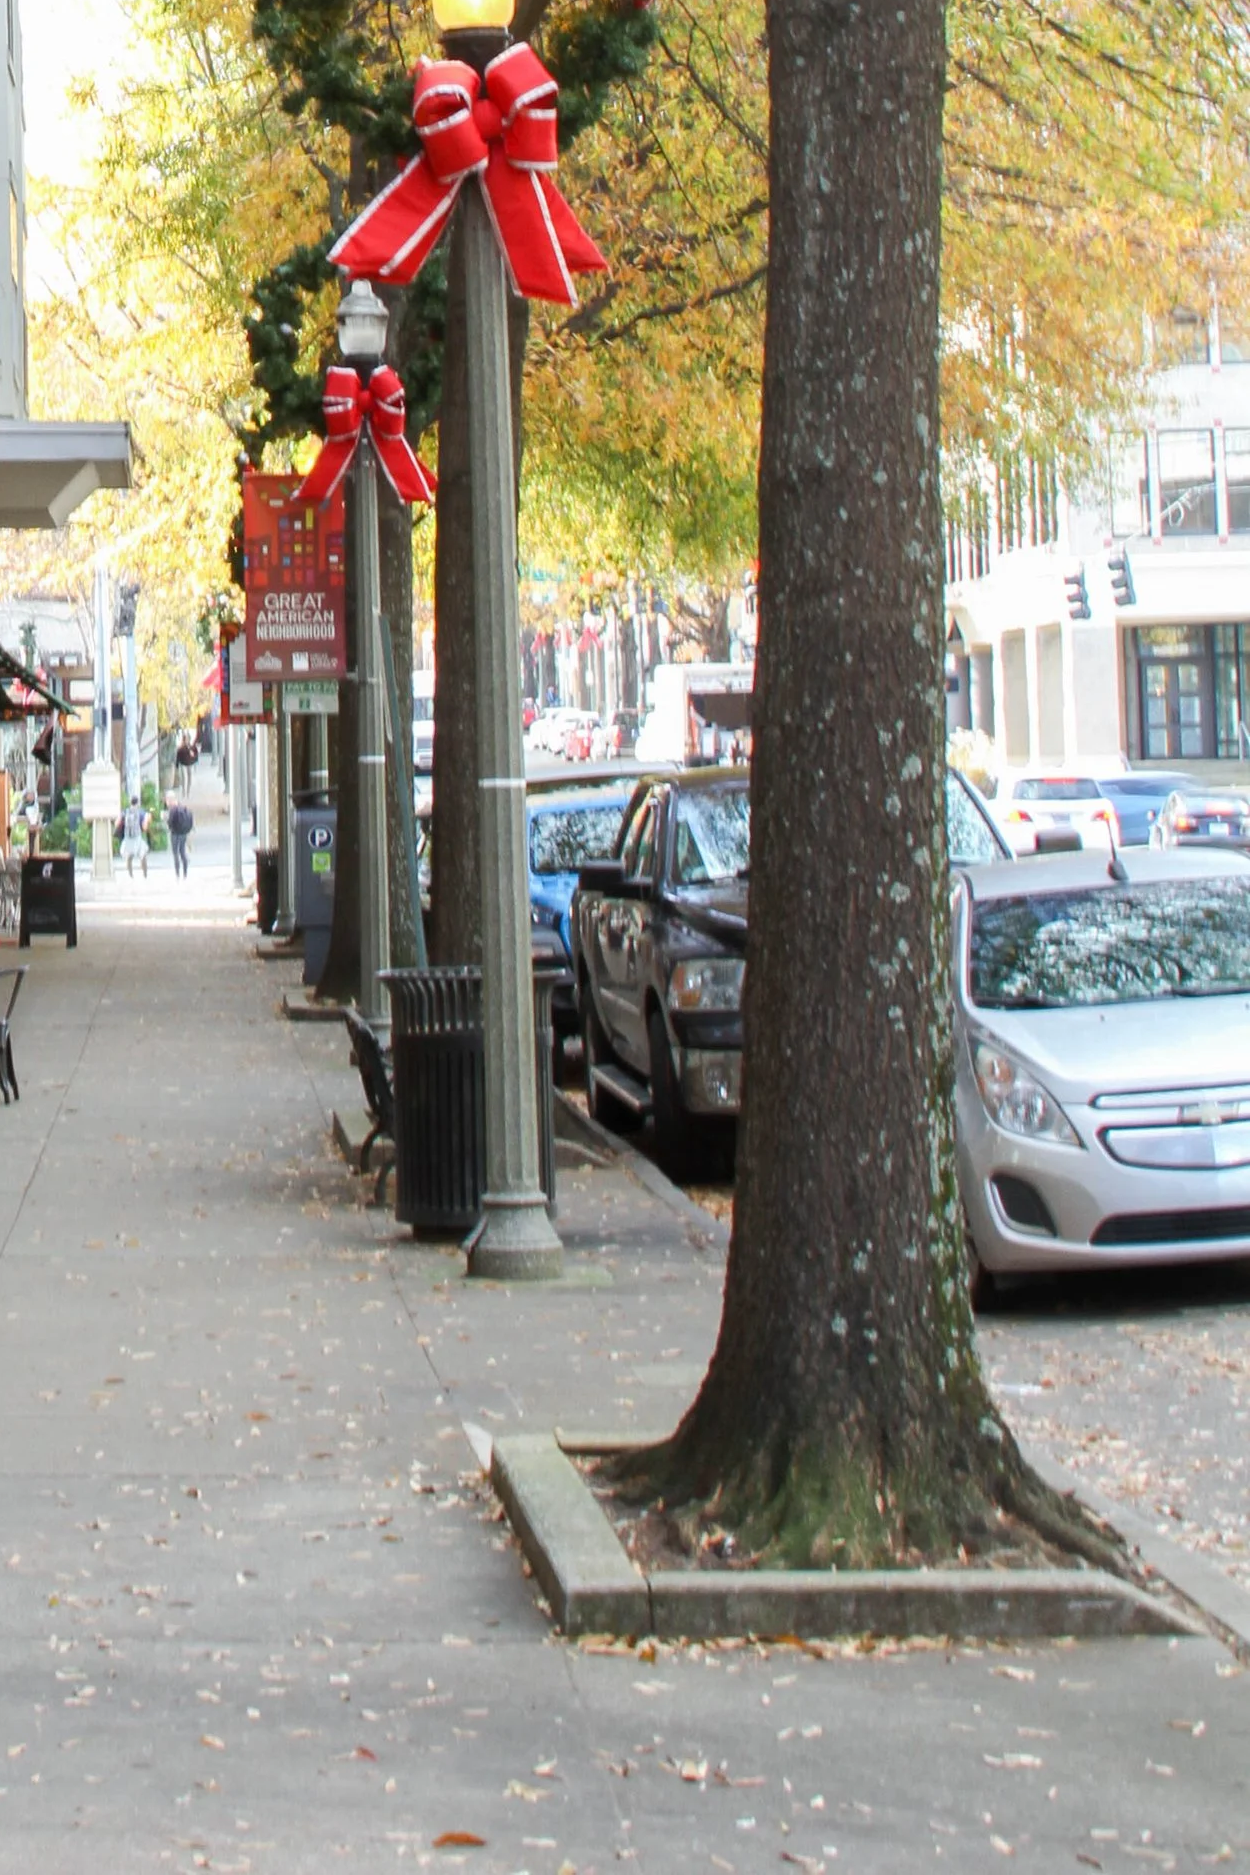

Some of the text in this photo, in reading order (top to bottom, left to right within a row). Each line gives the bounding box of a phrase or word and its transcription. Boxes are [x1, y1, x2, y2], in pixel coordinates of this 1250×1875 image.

[264, 592, 325, 610] GREAT
[256, 610, 334, 624] AMERICAN
[256, 624, 335, 641] NEIGHBORHOOD
